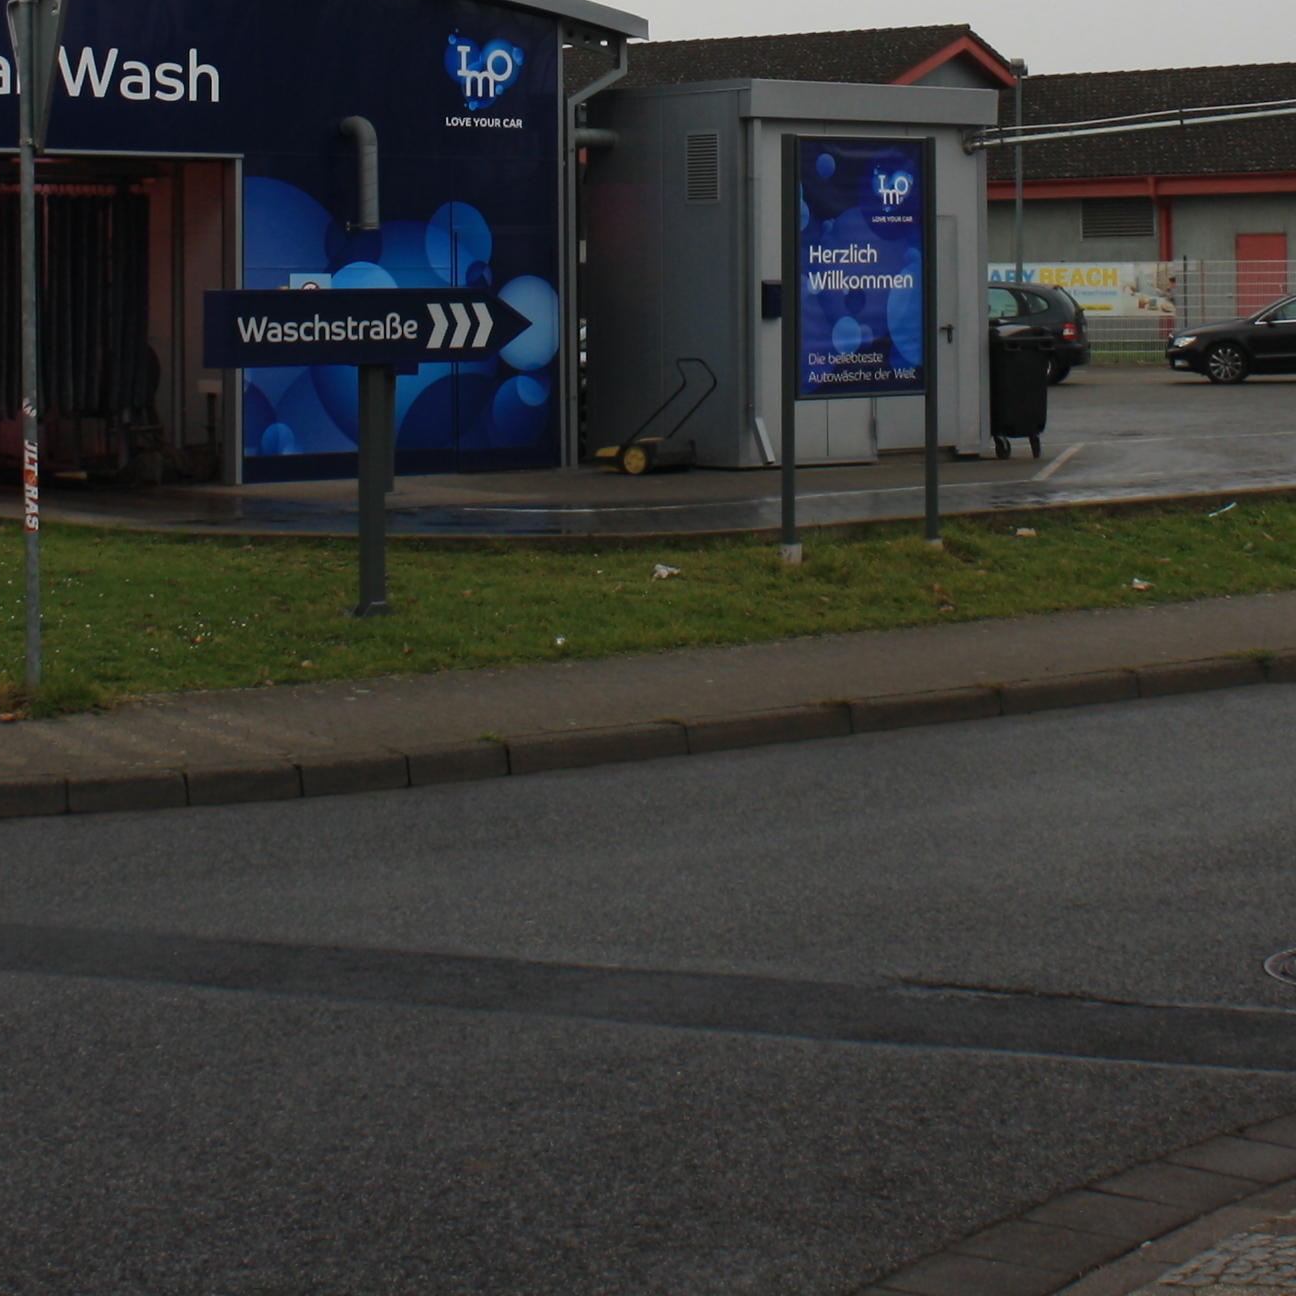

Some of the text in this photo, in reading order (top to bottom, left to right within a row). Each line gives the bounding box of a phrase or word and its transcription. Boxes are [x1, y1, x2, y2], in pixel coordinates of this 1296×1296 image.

[58, 45, 220, 102] Wash
[445, 116, 523, 129] LOVE YOUR CAR
[809, 244, 878, 264] Herzlich
[808, 270, 914, 290] Willkommen
[1039, 267, 1119, 287] BEACH
[237, 312, 419, 343] Waschstraße
[808, 351, 884, 365] Die beliebteste
[808, 367, 917, 383] Autowäsche der Welt
